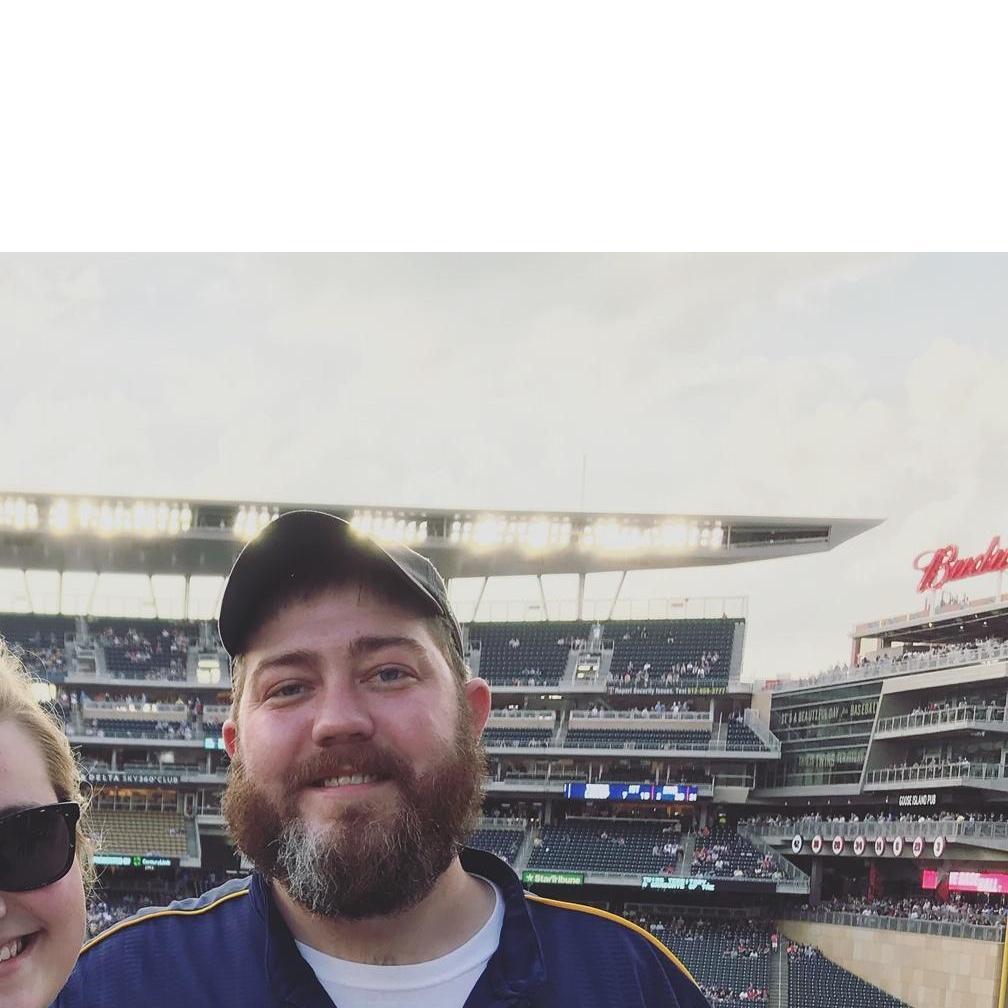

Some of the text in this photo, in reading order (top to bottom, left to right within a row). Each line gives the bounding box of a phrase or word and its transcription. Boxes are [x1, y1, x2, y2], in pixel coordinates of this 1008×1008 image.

[89, 773, 119, 782] DELTA
[898, 793, 937, 807] GOOSE ISLAND PUB
[534, 873, 581, 885] StarTribune
